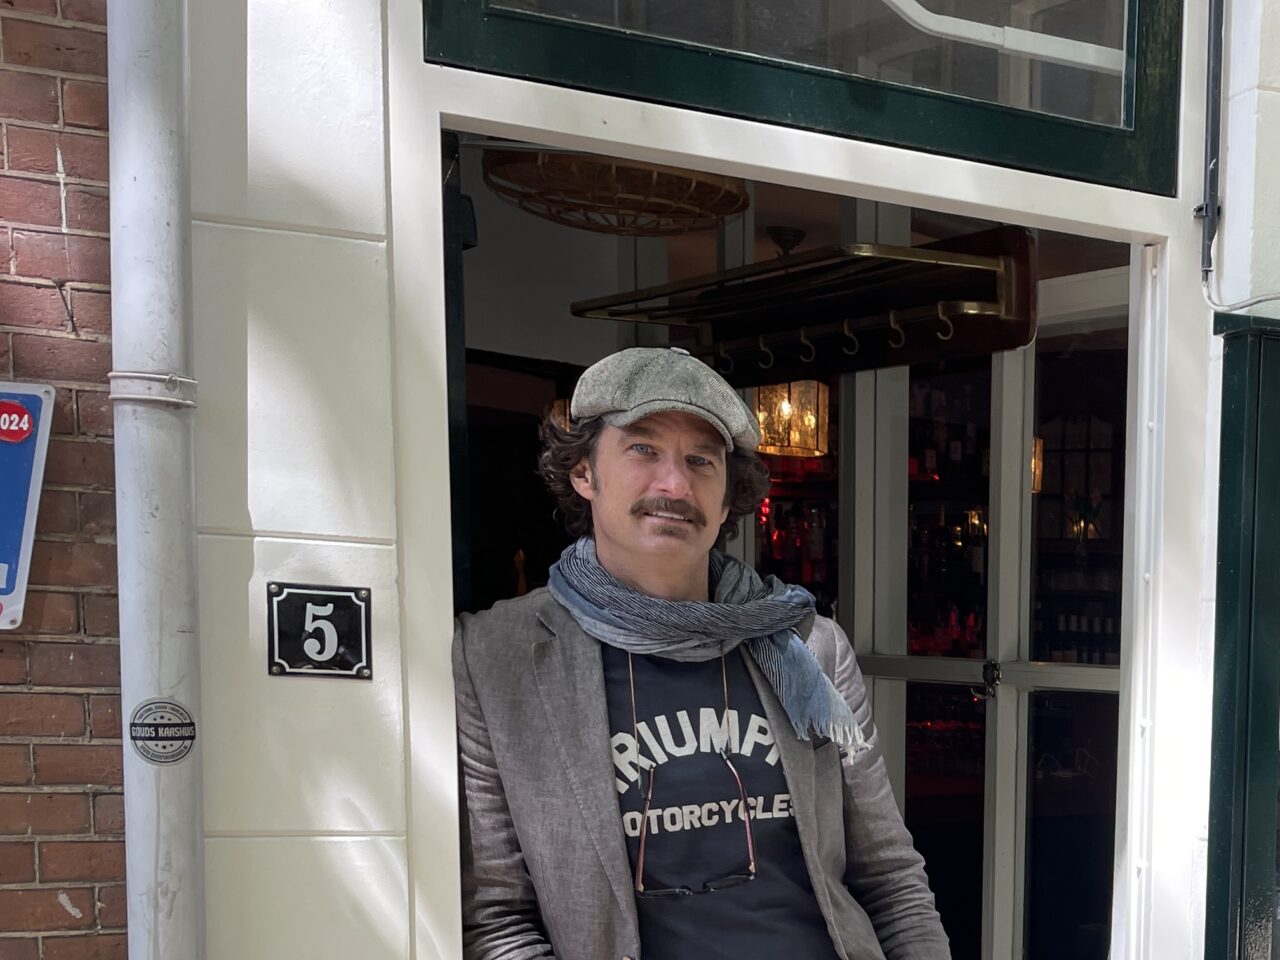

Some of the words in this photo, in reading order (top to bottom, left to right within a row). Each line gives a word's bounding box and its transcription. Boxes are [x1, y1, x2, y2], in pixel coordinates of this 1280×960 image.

[0, 413, 29, 431] 024
[303, 602, 338, 661] 5
[131, 726, 156, 737] GOUDS
[158, 726, 194, 737] KAASHUIS
[610, 707, 782, 794] RIUMP
[622, 793, 796, 837] OTORCYCLE
